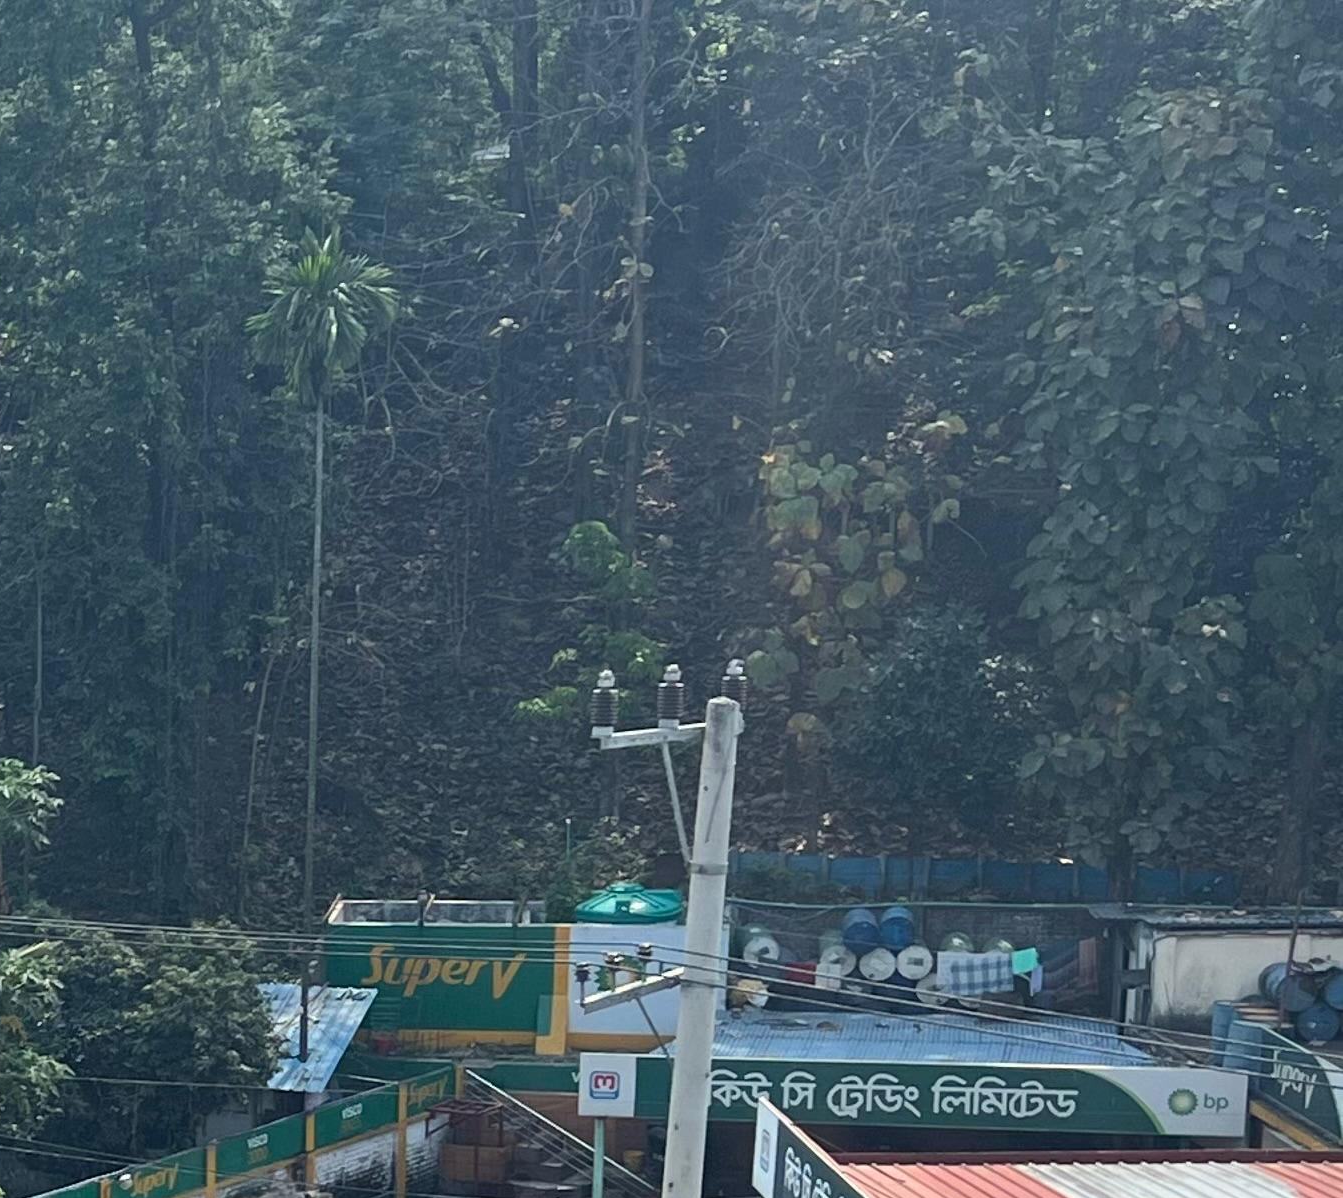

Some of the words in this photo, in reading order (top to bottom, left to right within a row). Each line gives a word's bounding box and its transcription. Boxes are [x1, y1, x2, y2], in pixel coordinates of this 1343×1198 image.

[780, 1071, 816, 1110] সি
[826, 1073, 921, 1119] ট্রেডিং
[931, 1075, 1079, 1119] লিমিটেড
[1203, 1093, 1229, 1113] bp
